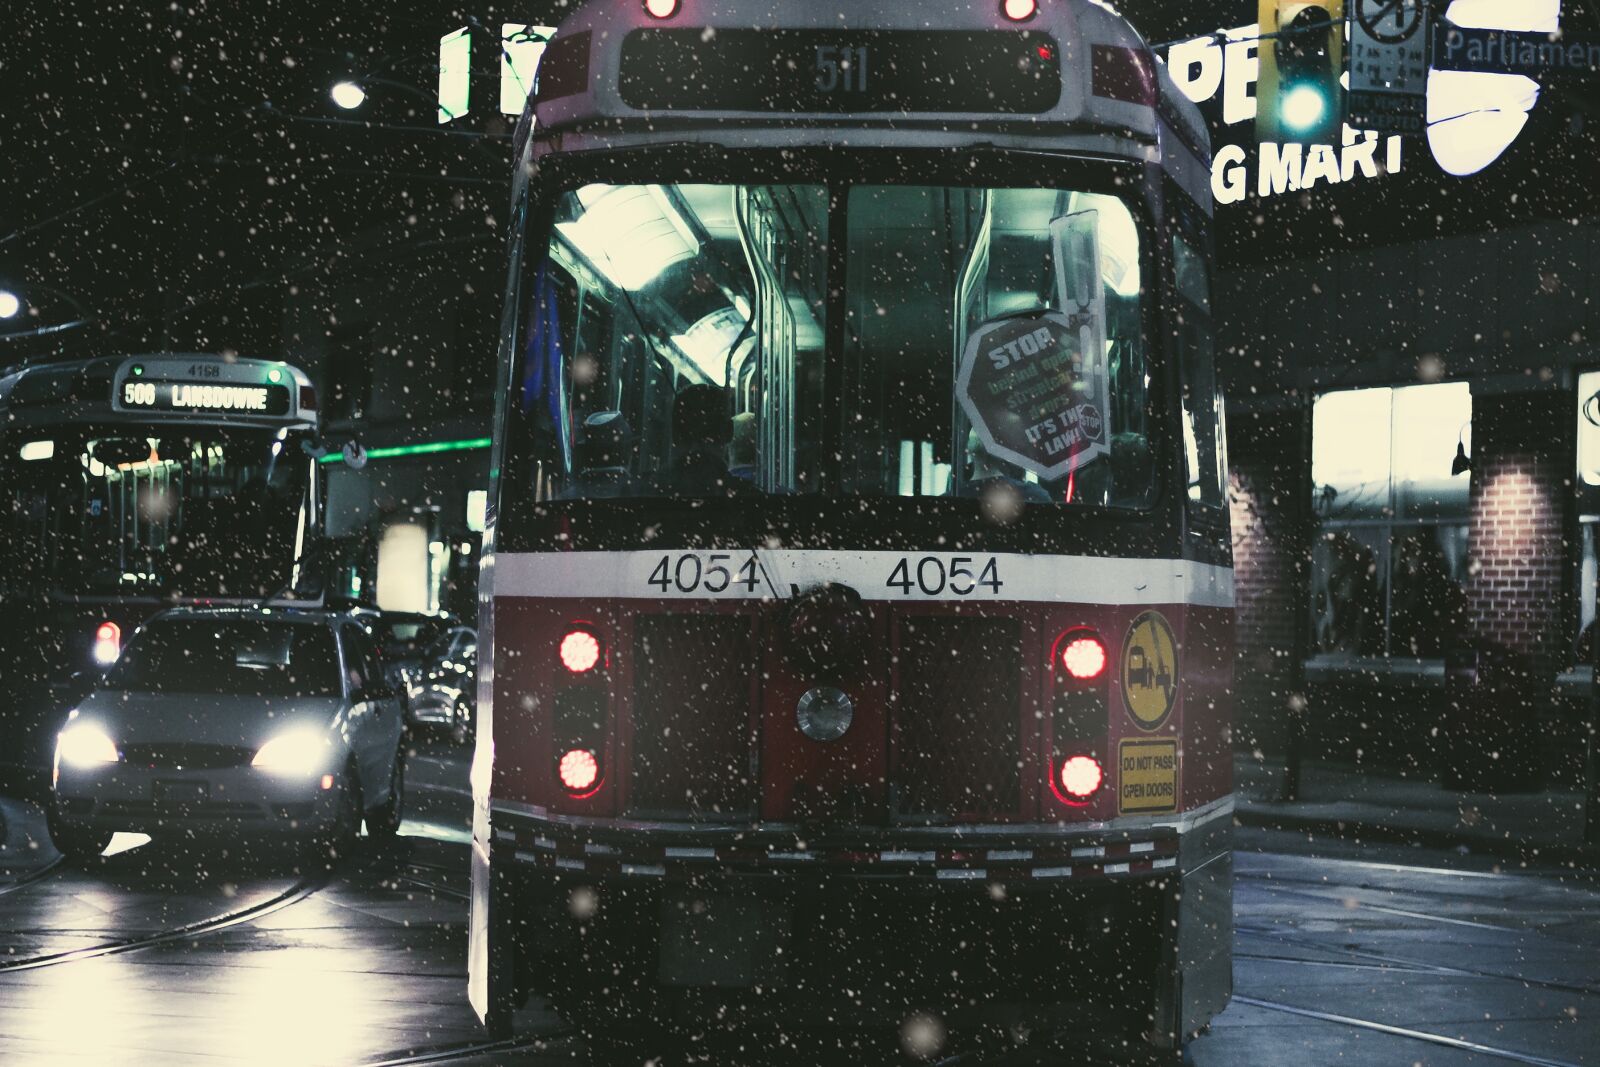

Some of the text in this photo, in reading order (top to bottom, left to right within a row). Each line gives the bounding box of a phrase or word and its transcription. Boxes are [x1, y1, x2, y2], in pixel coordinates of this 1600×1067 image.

[815, 44, 867, 92] 511
[989, 327, 1053, 370] STOP
[172, 384, 268, 410] LANSDOWNE
[1025, 418, 1057, 444] IT'S
[647, 553, 761, 594] 4054
[886, 556, 1004, 596] 4054
[1123, 756, 1173, 771] DO NOT PASS
[1123, 782, 1174, 798] OPEN DOORS
